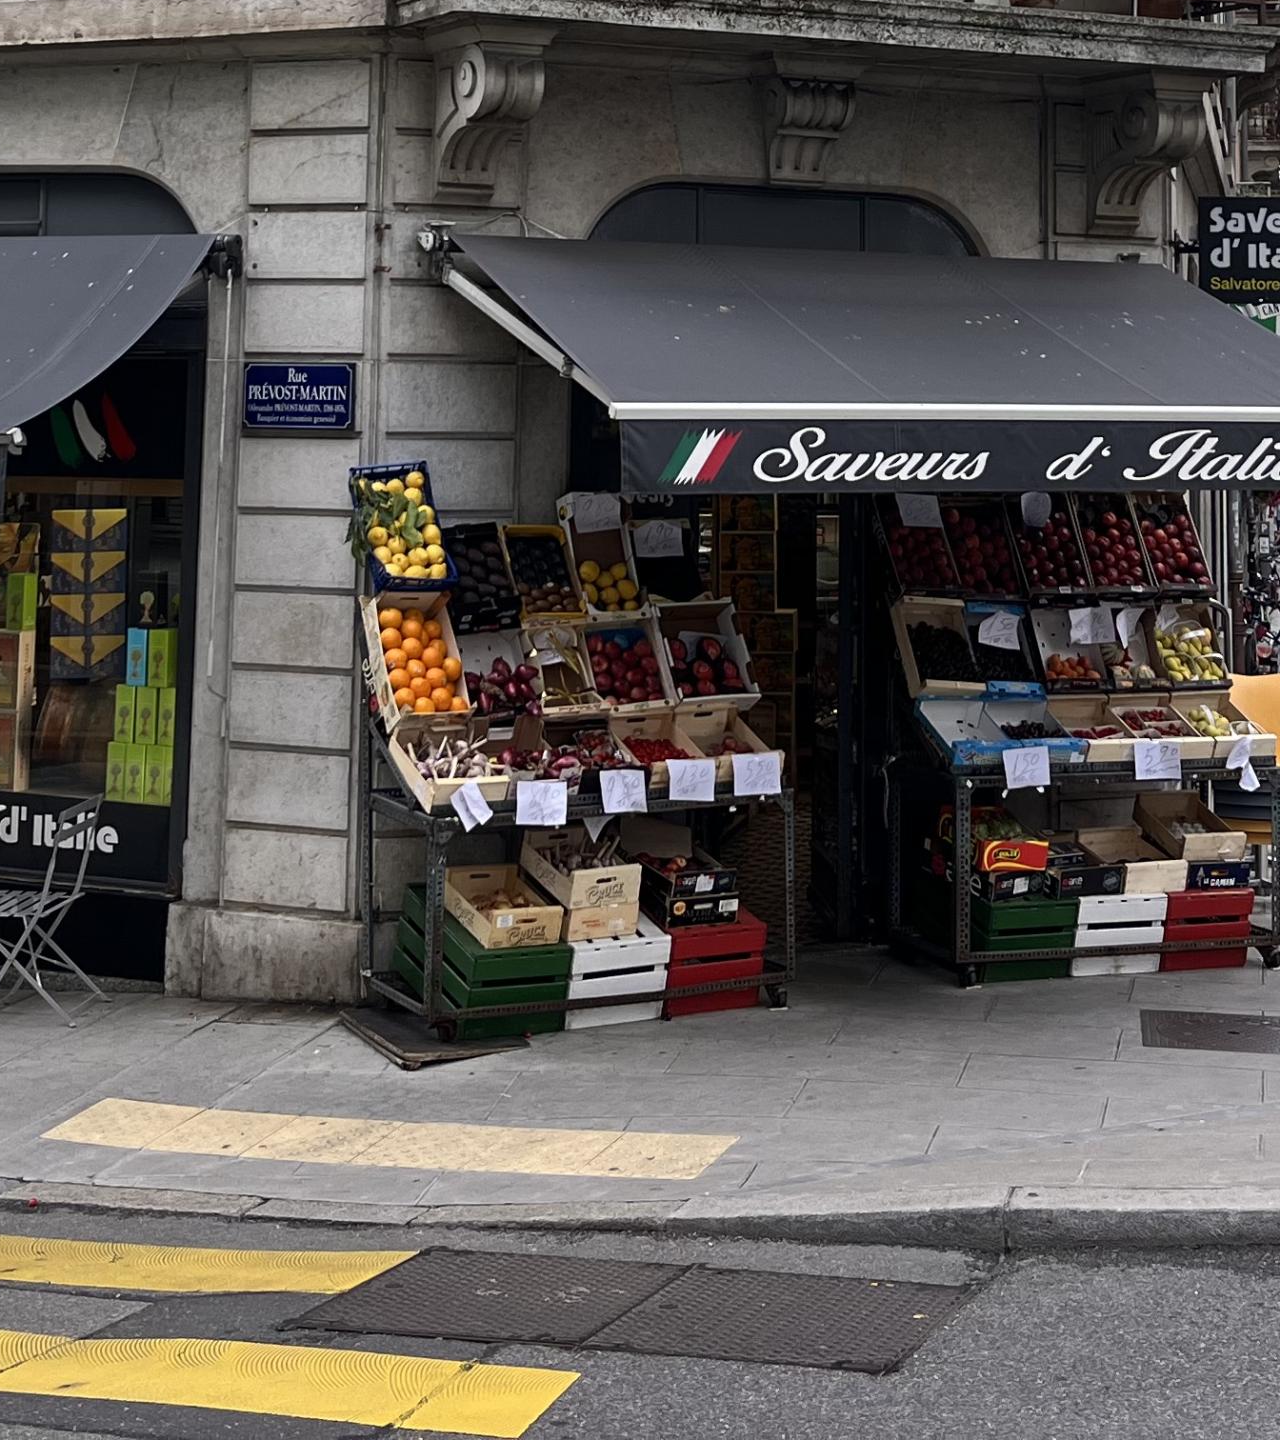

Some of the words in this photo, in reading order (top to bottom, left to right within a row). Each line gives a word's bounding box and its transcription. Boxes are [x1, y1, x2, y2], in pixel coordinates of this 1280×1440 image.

[1210, 276, 1280, 291] Salvatore
[287, 367, 308, 383] Rue
[248, 382, 347, 401] PRÉVOST-MARTIN
[752, 426, 991, 483] Saveurs
